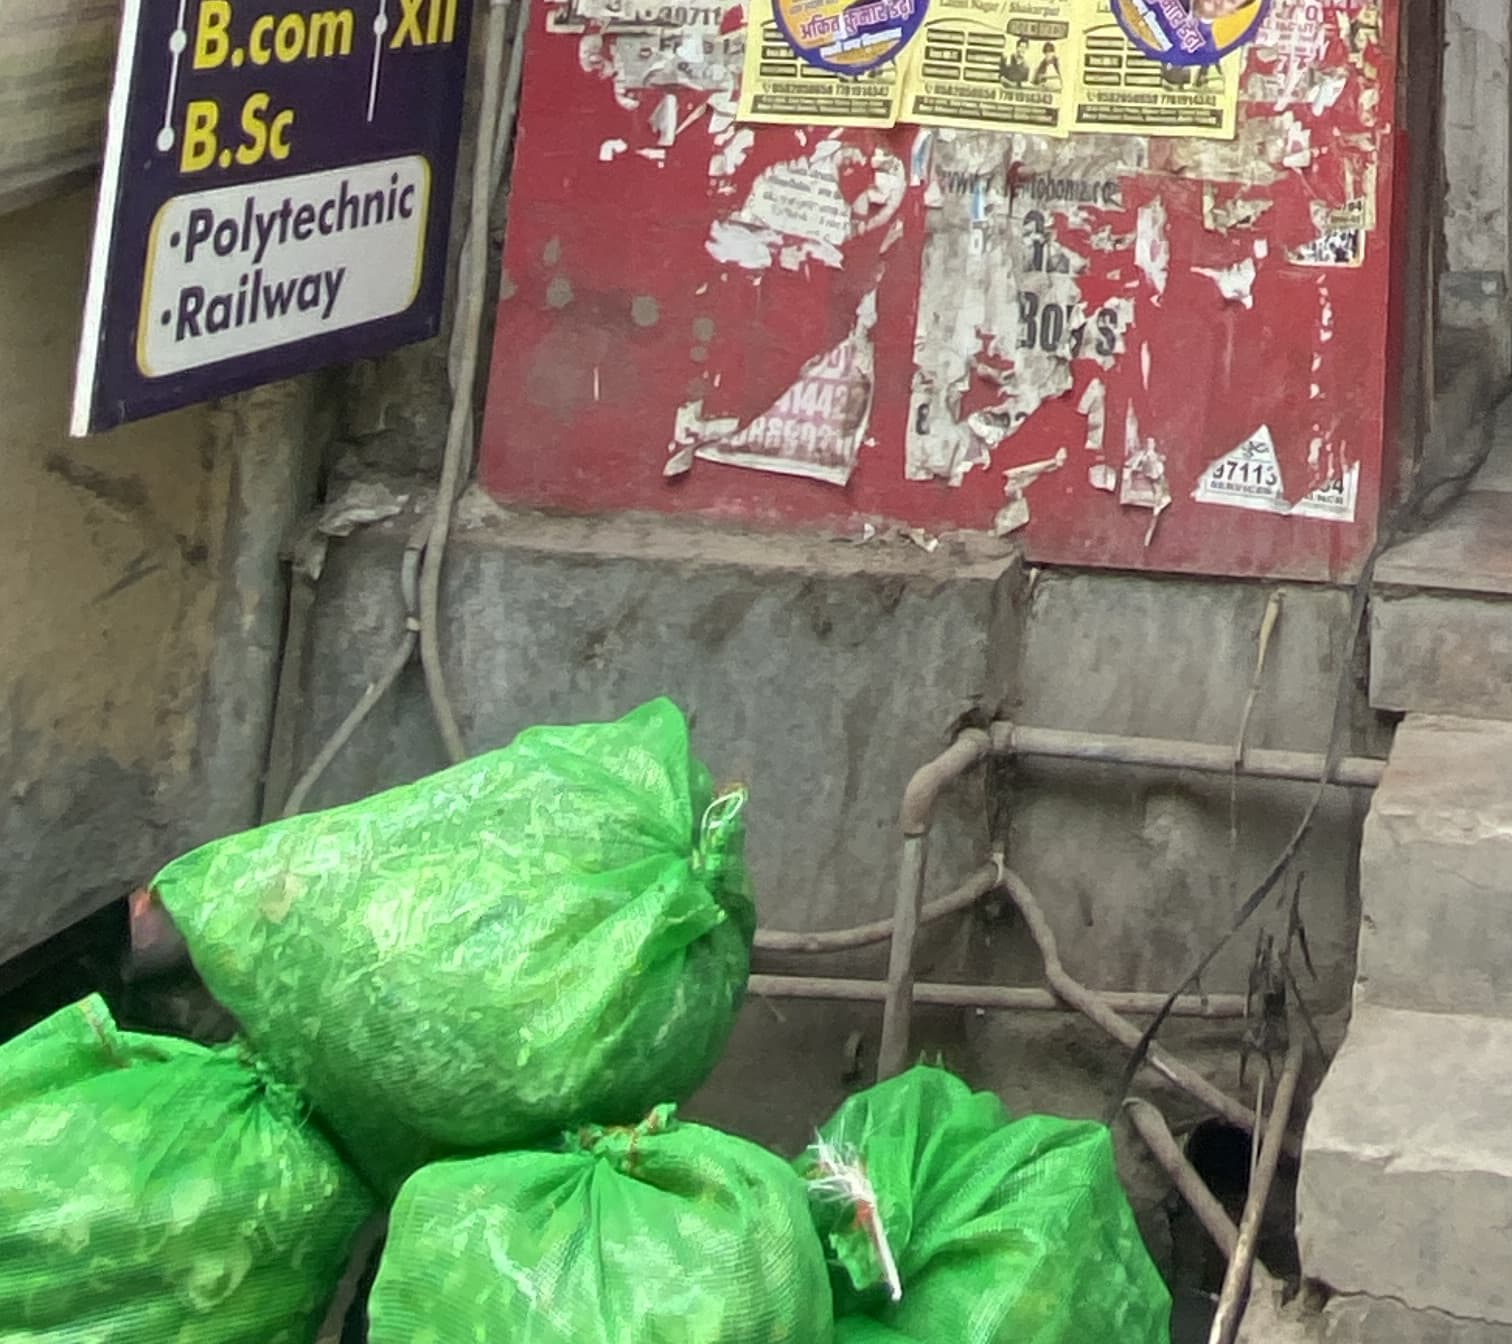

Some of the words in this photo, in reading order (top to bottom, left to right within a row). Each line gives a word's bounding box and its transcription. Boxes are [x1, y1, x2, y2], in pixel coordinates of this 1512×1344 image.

[179, 92, 295, 174] B.Sc
[184, 172, 416, 265] Polytechnic
[175, 266, 347, 343] Railway
